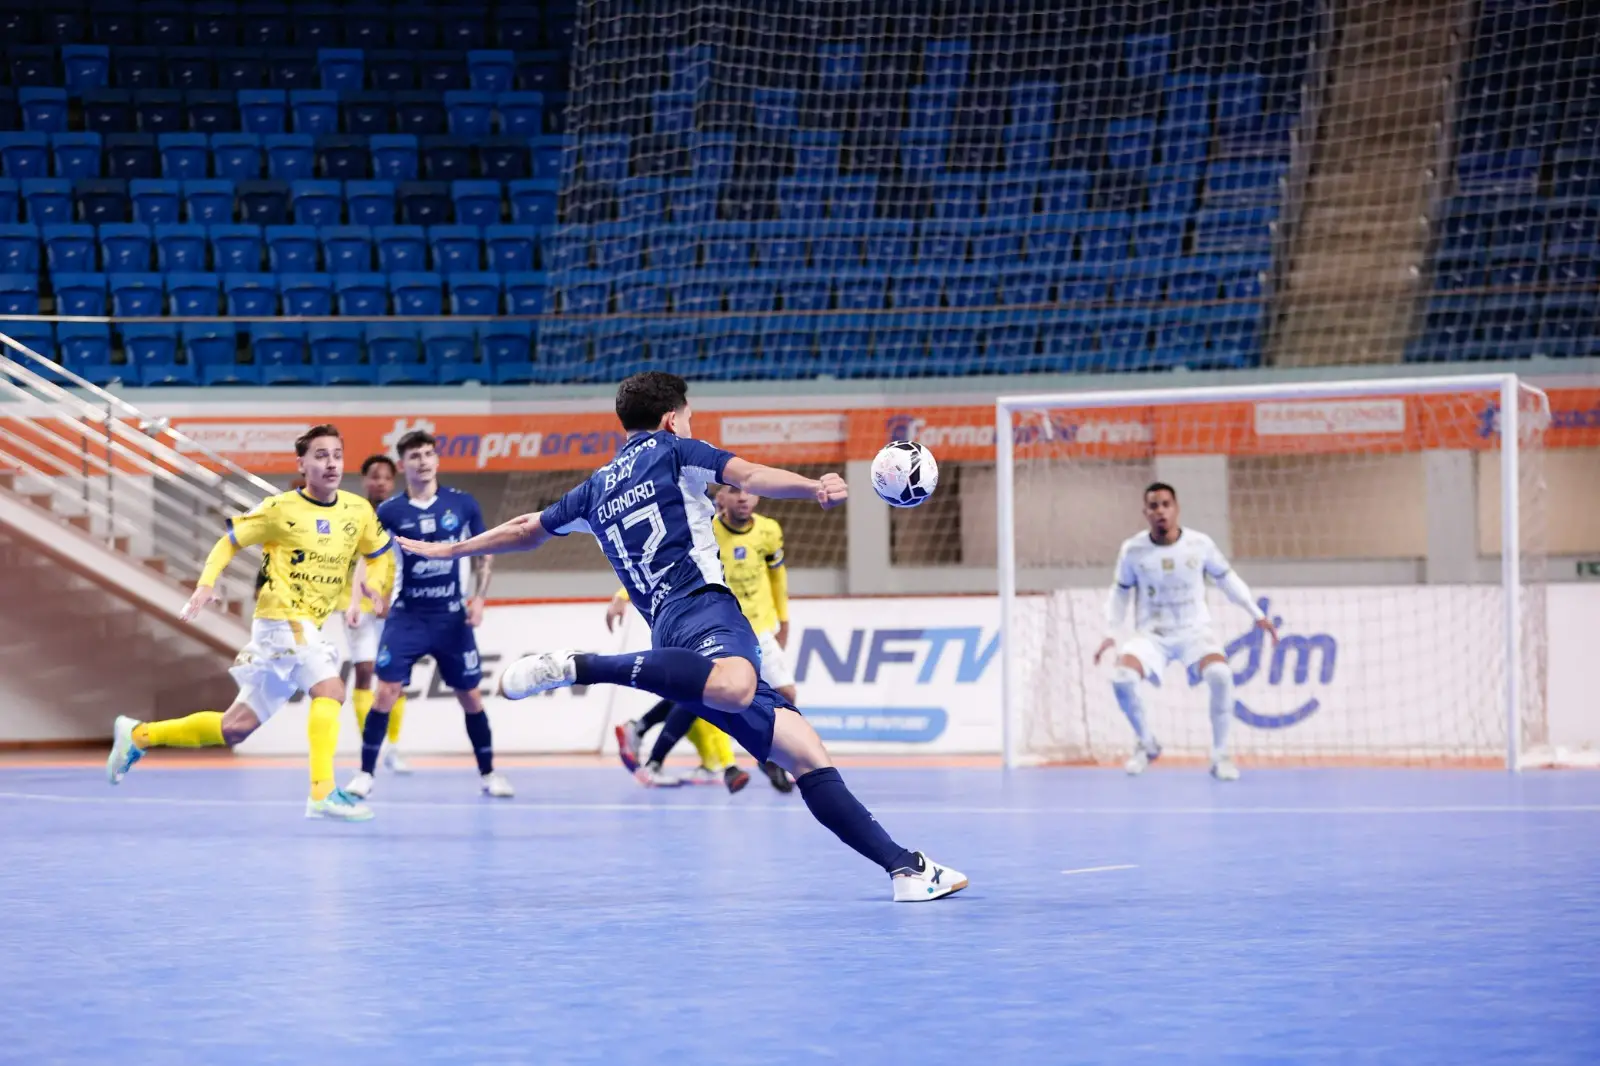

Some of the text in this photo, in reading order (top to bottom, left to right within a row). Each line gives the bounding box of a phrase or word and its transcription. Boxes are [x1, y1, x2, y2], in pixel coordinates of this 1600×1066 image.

[597, 480, 656, 525] EVANDRO
[604, 502, 675, 595] 12
[463, 650, 479, 669] 10
